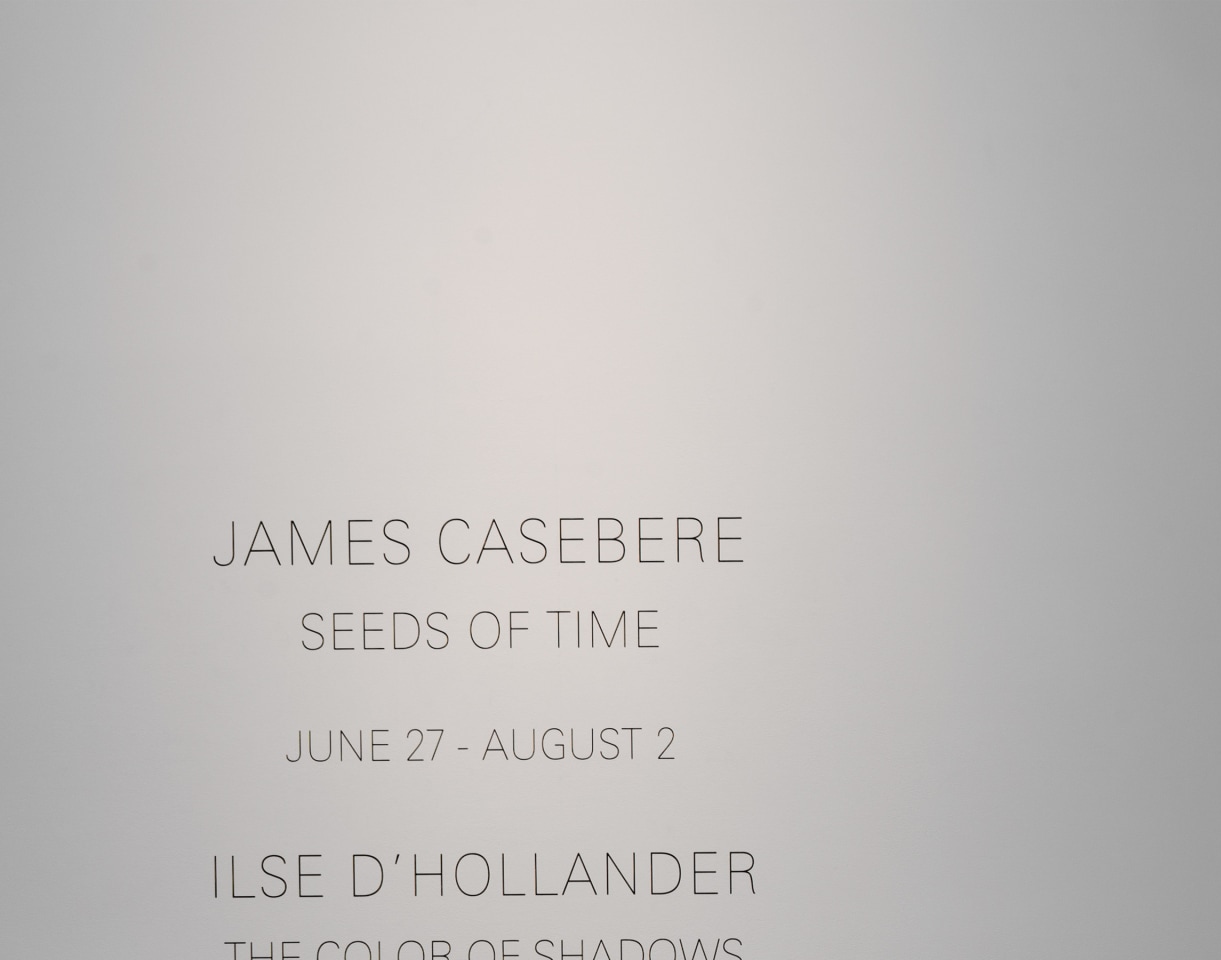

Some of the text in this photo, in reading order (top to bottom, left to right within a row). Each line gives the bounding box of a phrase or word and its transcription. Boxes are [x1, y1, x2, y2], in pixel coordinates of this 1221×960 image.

[213, 517, 744, 567] JAMES CASEBERE
[302, 610, 659, 651] SEEDS OF TIME
[286, 729, 390, 762] JUNE
[407, 729, 444, 761] 27
[482, 728, 642, 760] AUGUST
[658, 727, 675, 759] 2
[214, 851, 756, 898] ILSE D’HOLLANDER
